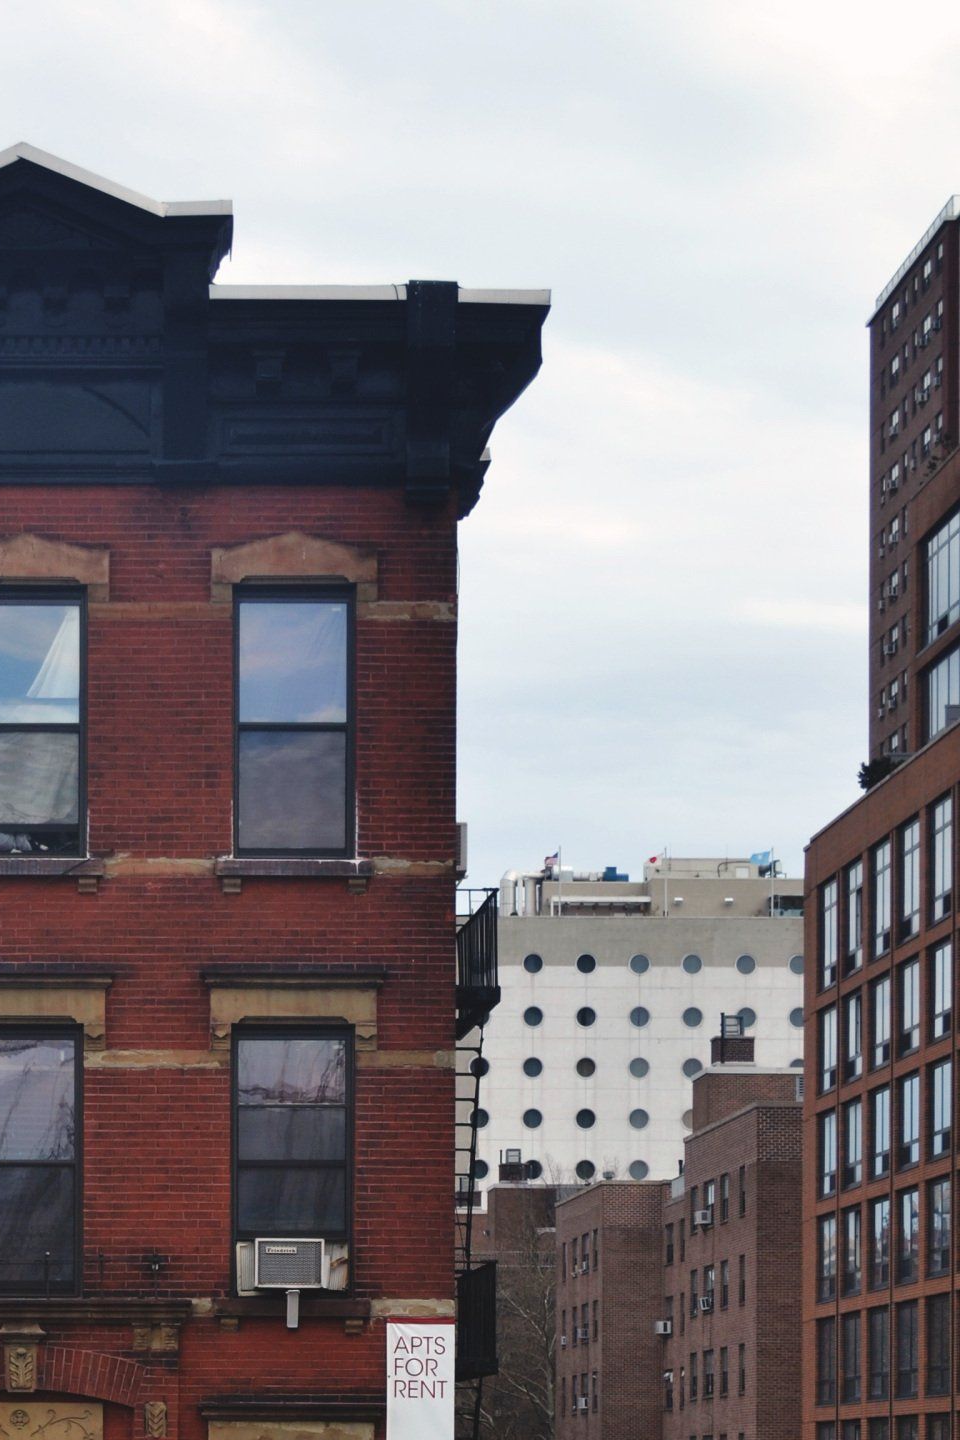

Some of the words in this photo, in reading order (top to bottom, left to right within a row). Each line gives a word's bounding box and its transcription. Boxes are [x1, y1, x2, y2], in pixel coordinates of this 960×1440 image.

[393, 1335, 446, 1355] APTS
[394, 1357, 438, 1377] FOR
[394, 1379, 448, 1399] RENT
